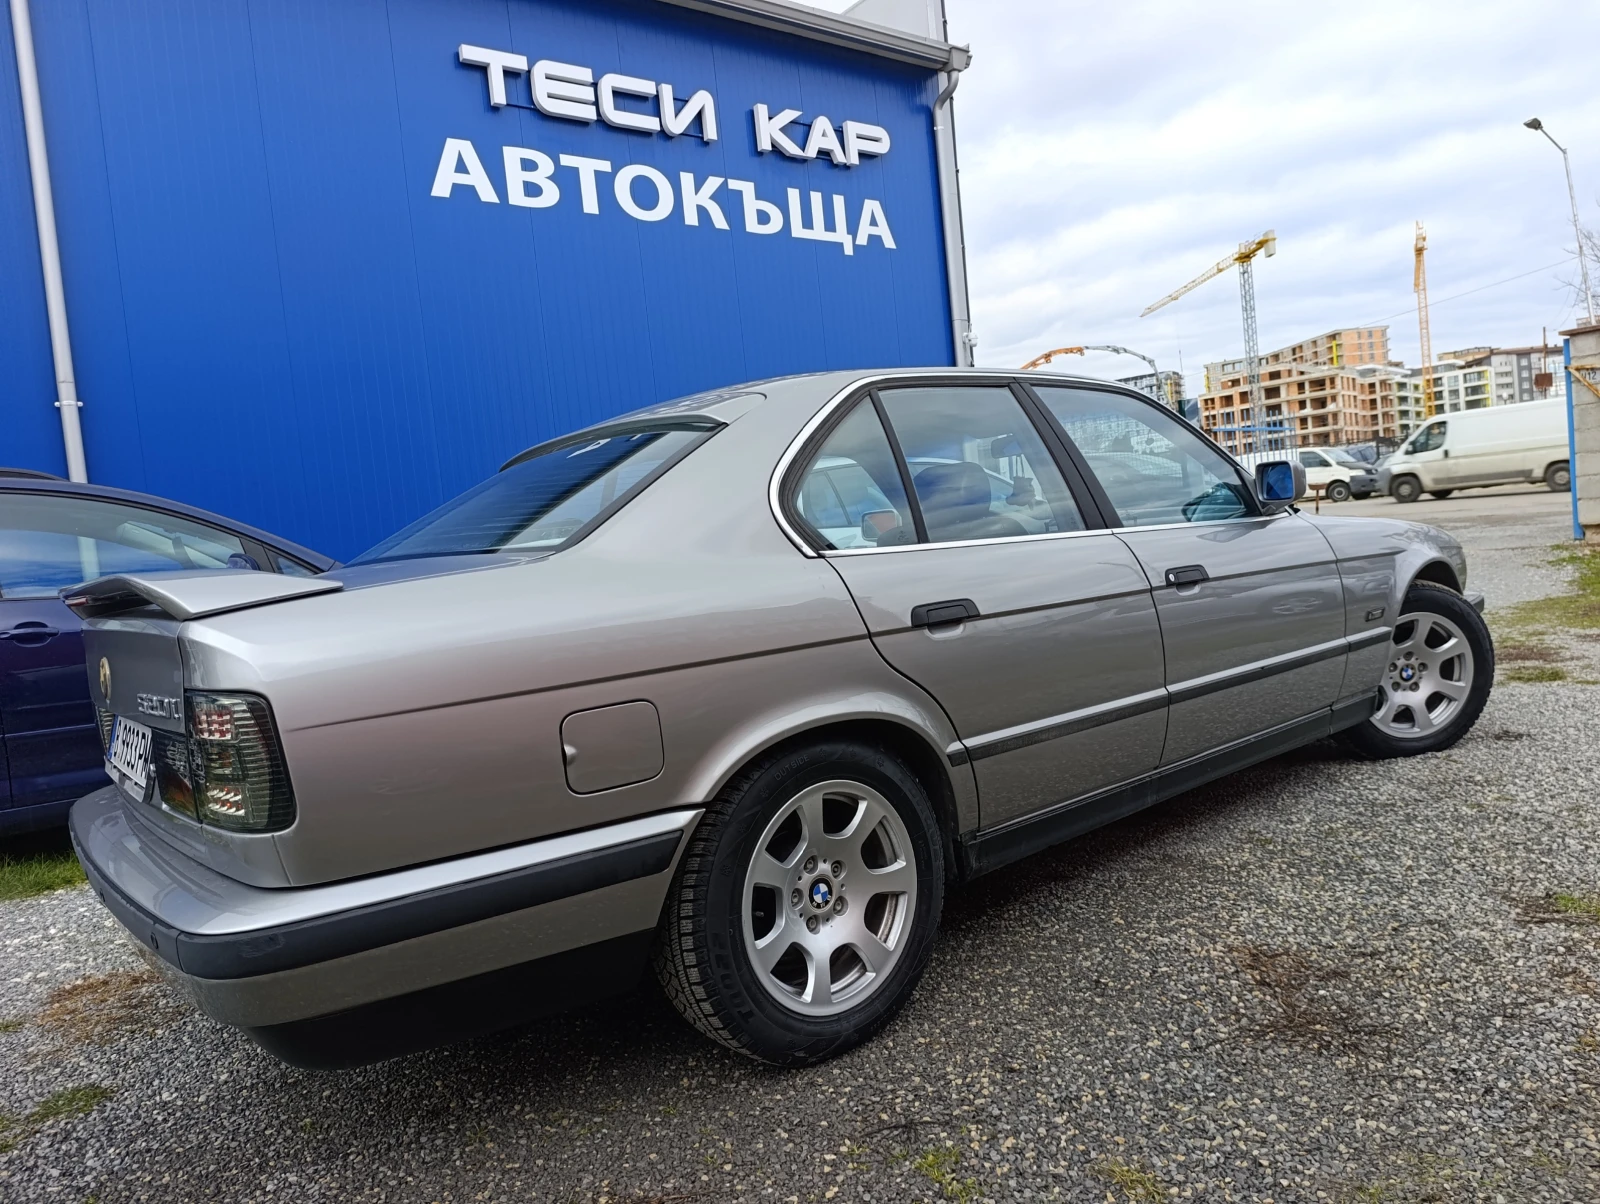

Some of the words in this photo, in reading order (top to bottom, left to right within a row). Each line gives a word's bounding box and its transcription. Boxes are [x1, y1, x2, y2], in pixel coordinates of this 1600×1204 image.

[458, 44, 718, 143] ТЕСИ
[753, 103, 891, 167] КАР
[430, 137, 897, 256] АВТОКЪЩА
[774, 754, 810, 781] OUTSIDE
